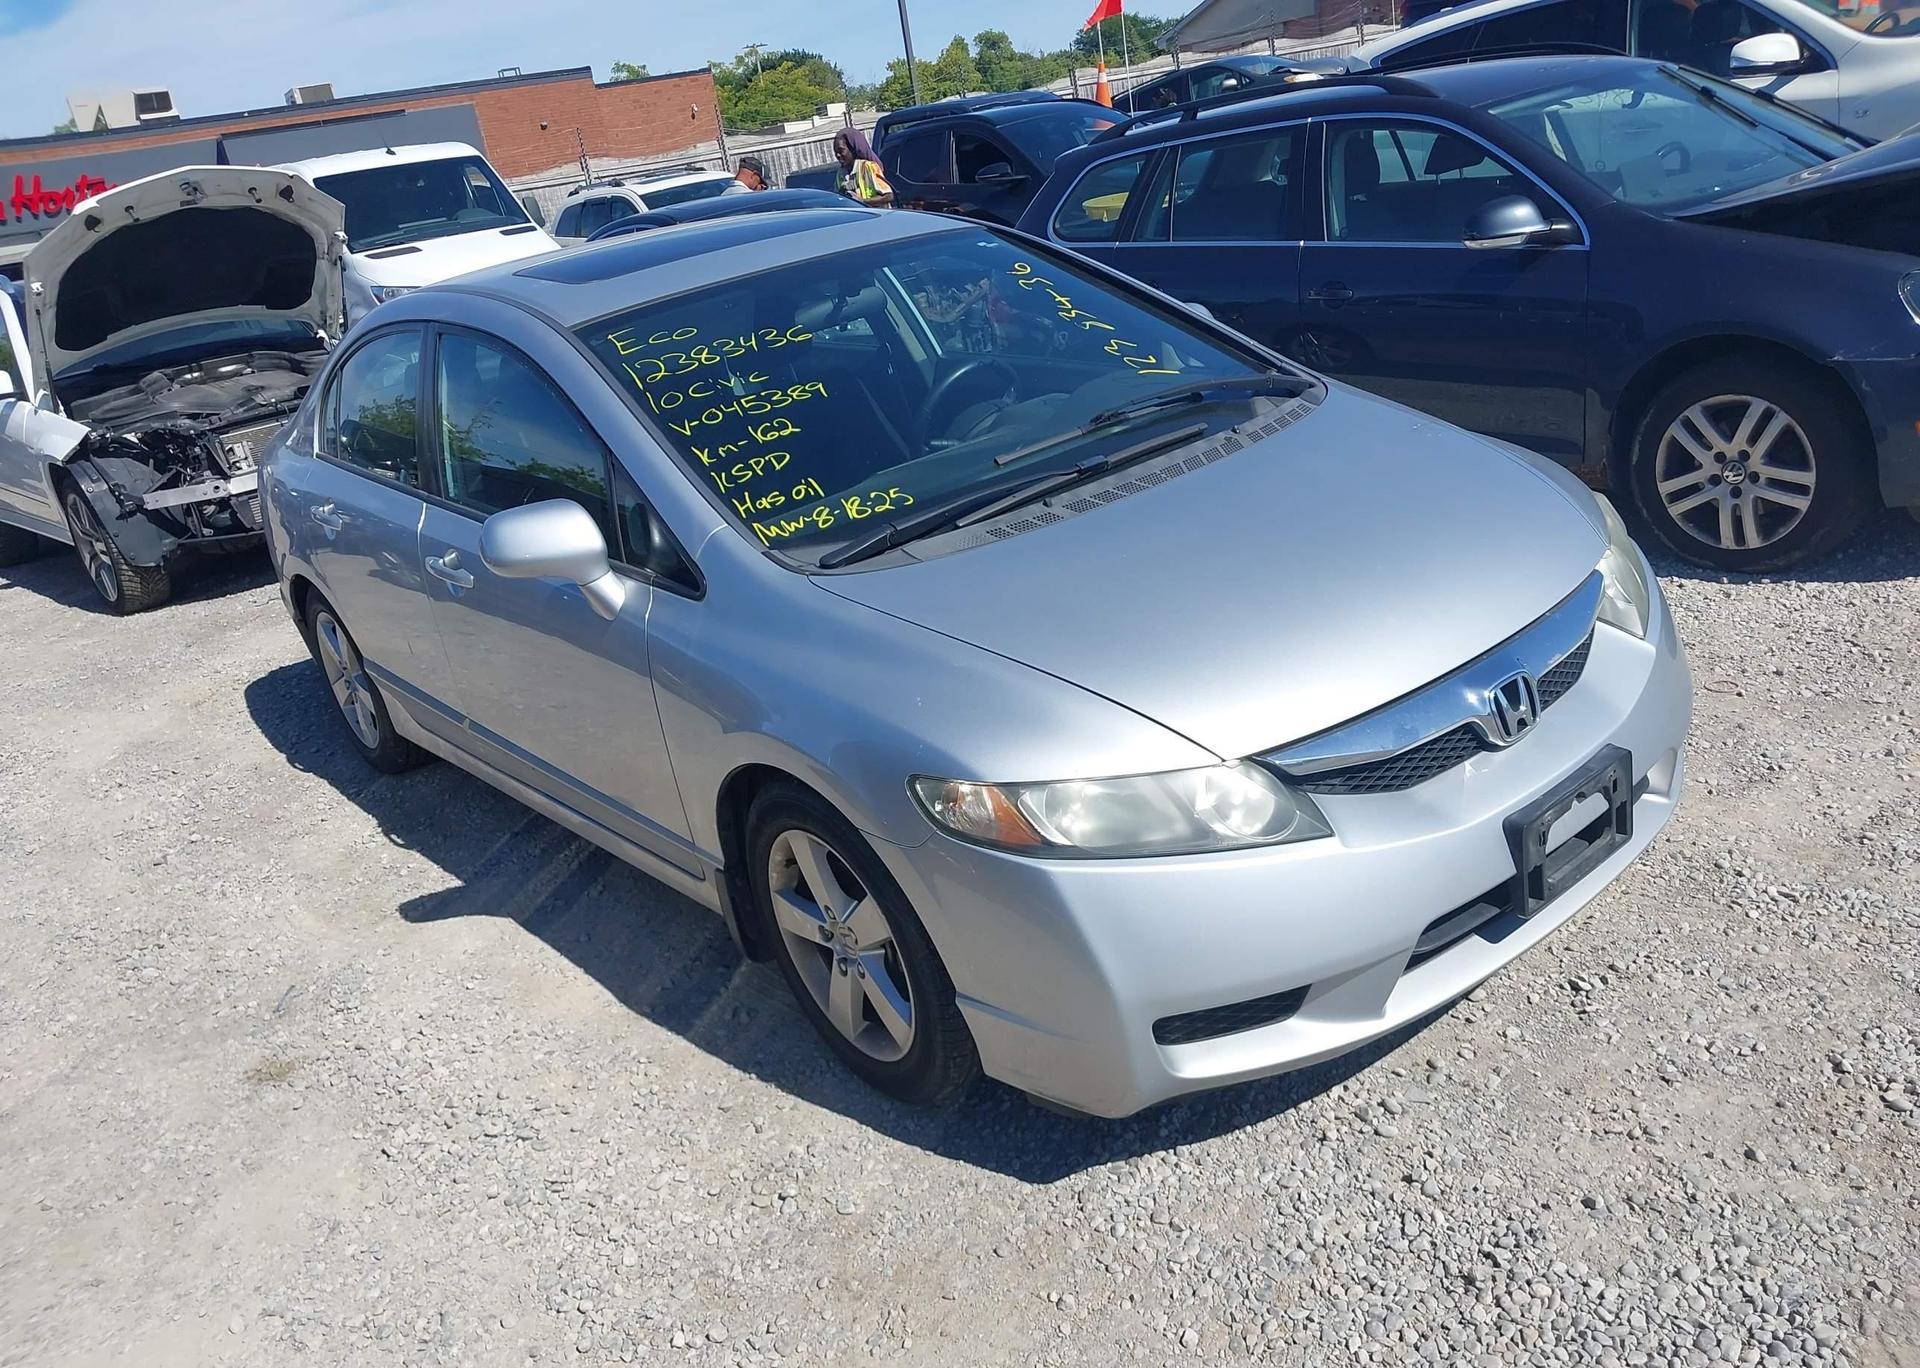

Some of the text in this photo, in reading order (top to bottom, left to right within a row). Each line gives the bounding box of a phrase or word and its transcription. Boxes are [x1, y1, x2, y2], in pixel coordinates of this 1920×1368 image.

[10, 174, 117, 223] Hort
[607, 327, 698, 355] Eco
[622, 325, 814, 391] 12383436
[731, 491, 786, 519] Has
